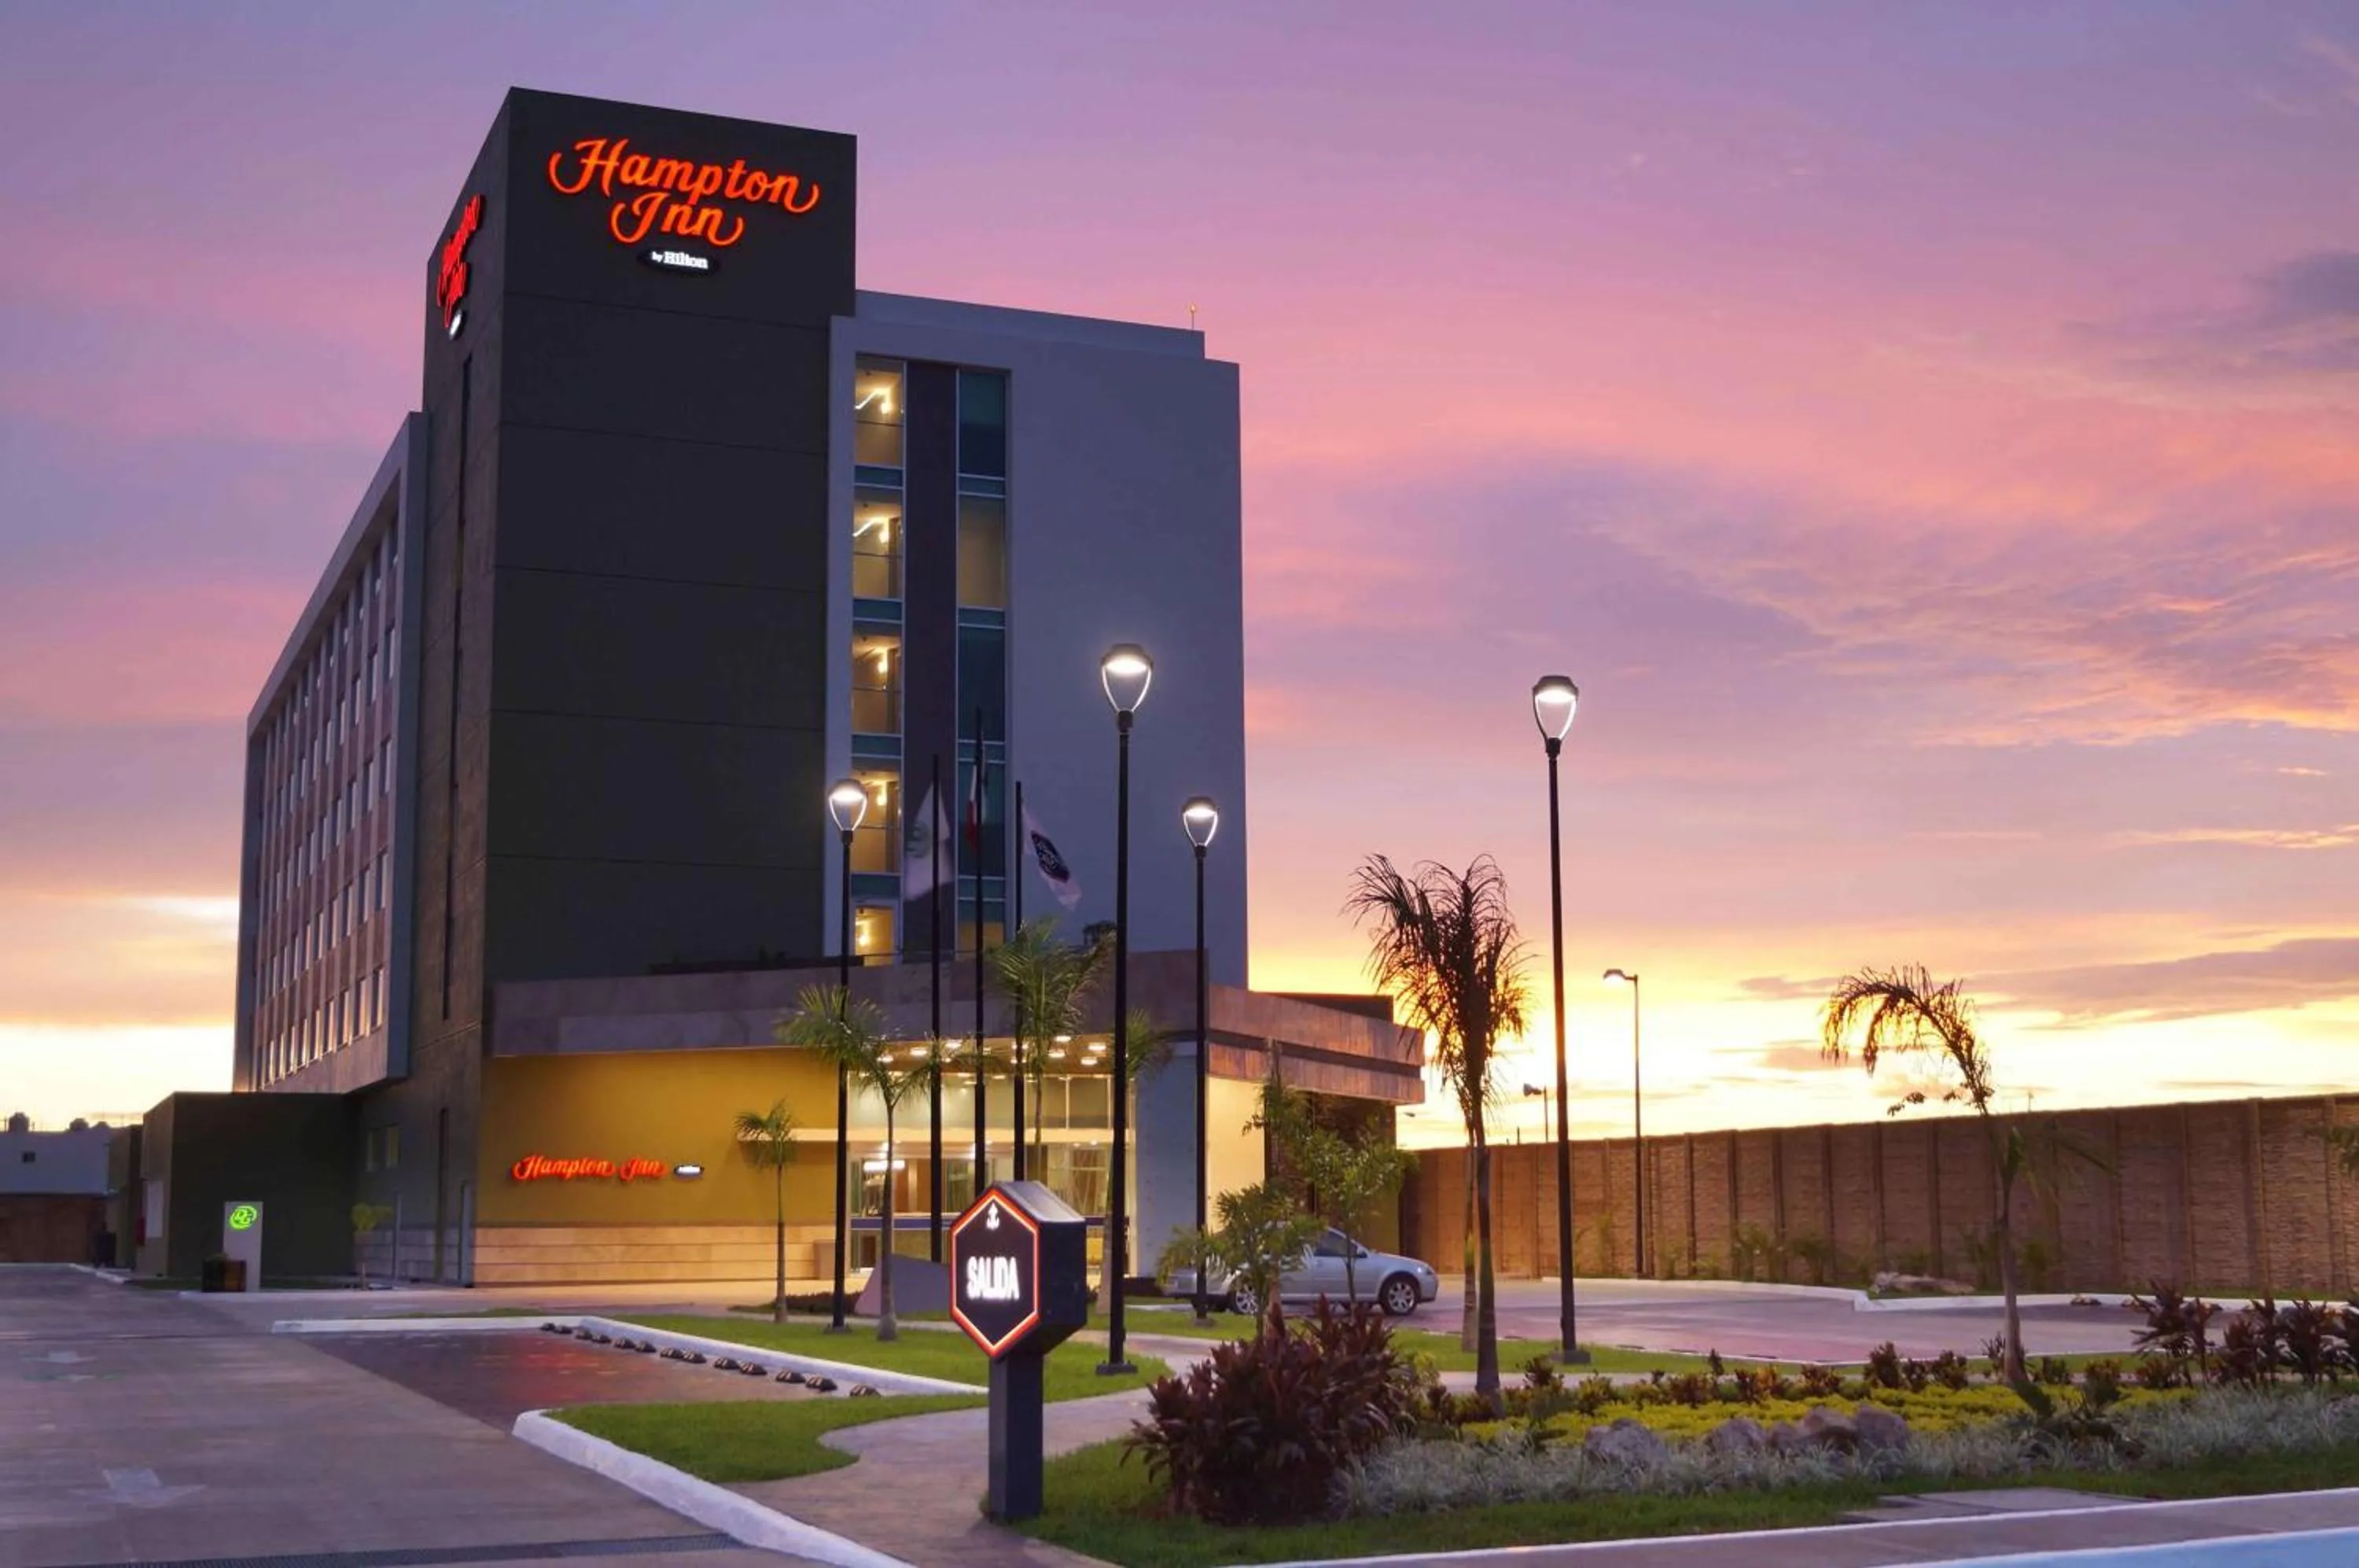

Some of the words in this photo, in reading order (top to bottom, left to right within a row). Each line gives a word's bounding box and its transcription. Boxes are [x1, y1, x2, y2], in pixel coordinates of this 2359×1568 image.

[549, 138, 819, 213] Hampton
[610, 191, 745, 246] Inn
[664, 251, 708, 269] Hilton
[513, 1154, 615, 1180] Hampton
[619, 1157, 668, 1181] Inn
[966, 1256, 1020, 1300] SALIDA
